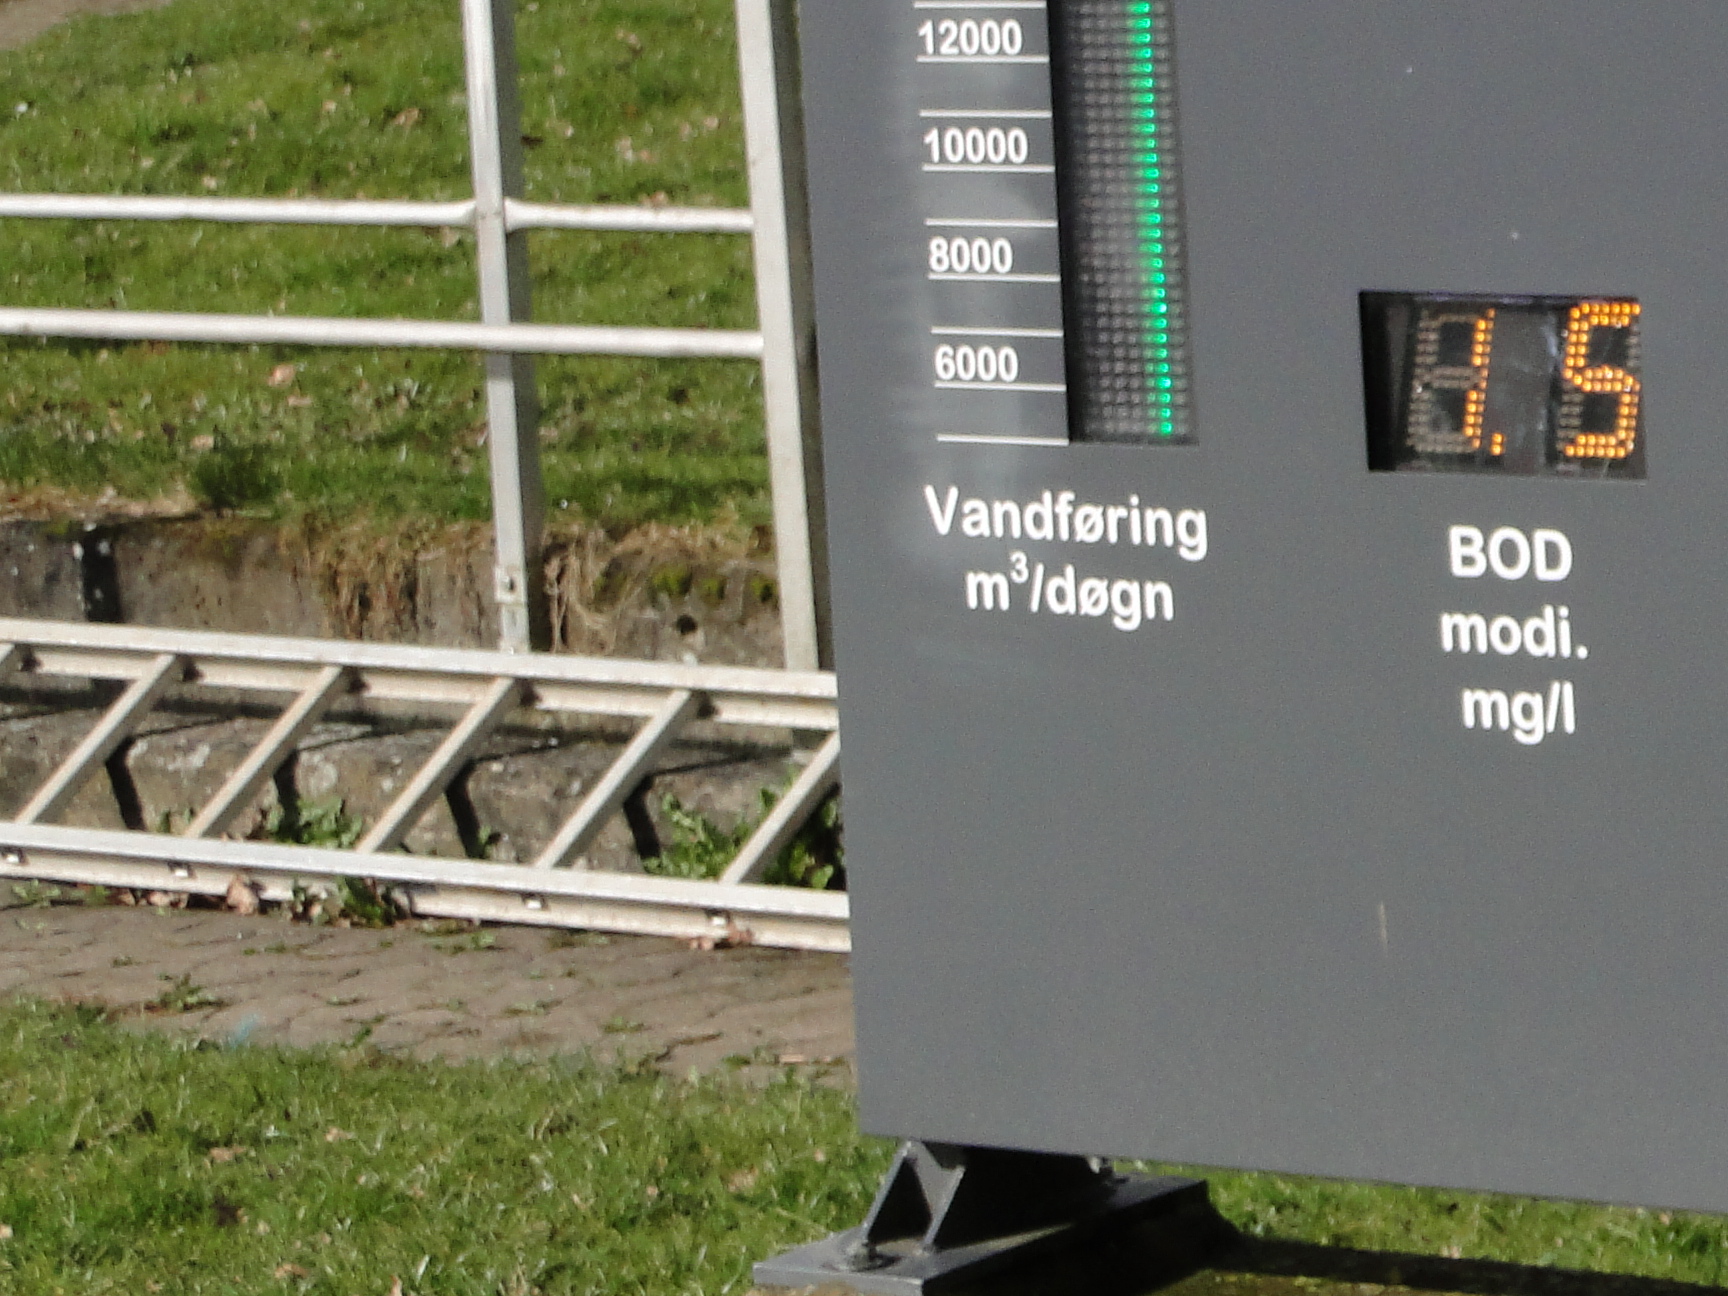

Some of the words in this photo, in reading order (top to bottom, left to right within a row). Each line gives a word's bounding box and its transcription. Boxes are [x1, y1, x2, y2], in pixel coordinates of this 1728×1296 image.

[917, 18, 1023, 55] 12000
[924, 127, 1029, 164] 10000
[928, 237, 1013, 273] 8000
[935, 344, 1019, 383] 6000
[925, 484, 1208, 561] Vandføring
[1449, 525, 1573, 582] BOD
[1440, 606, 1589, 659] modi.
[1461, 680, 1575, 745] mg/l
